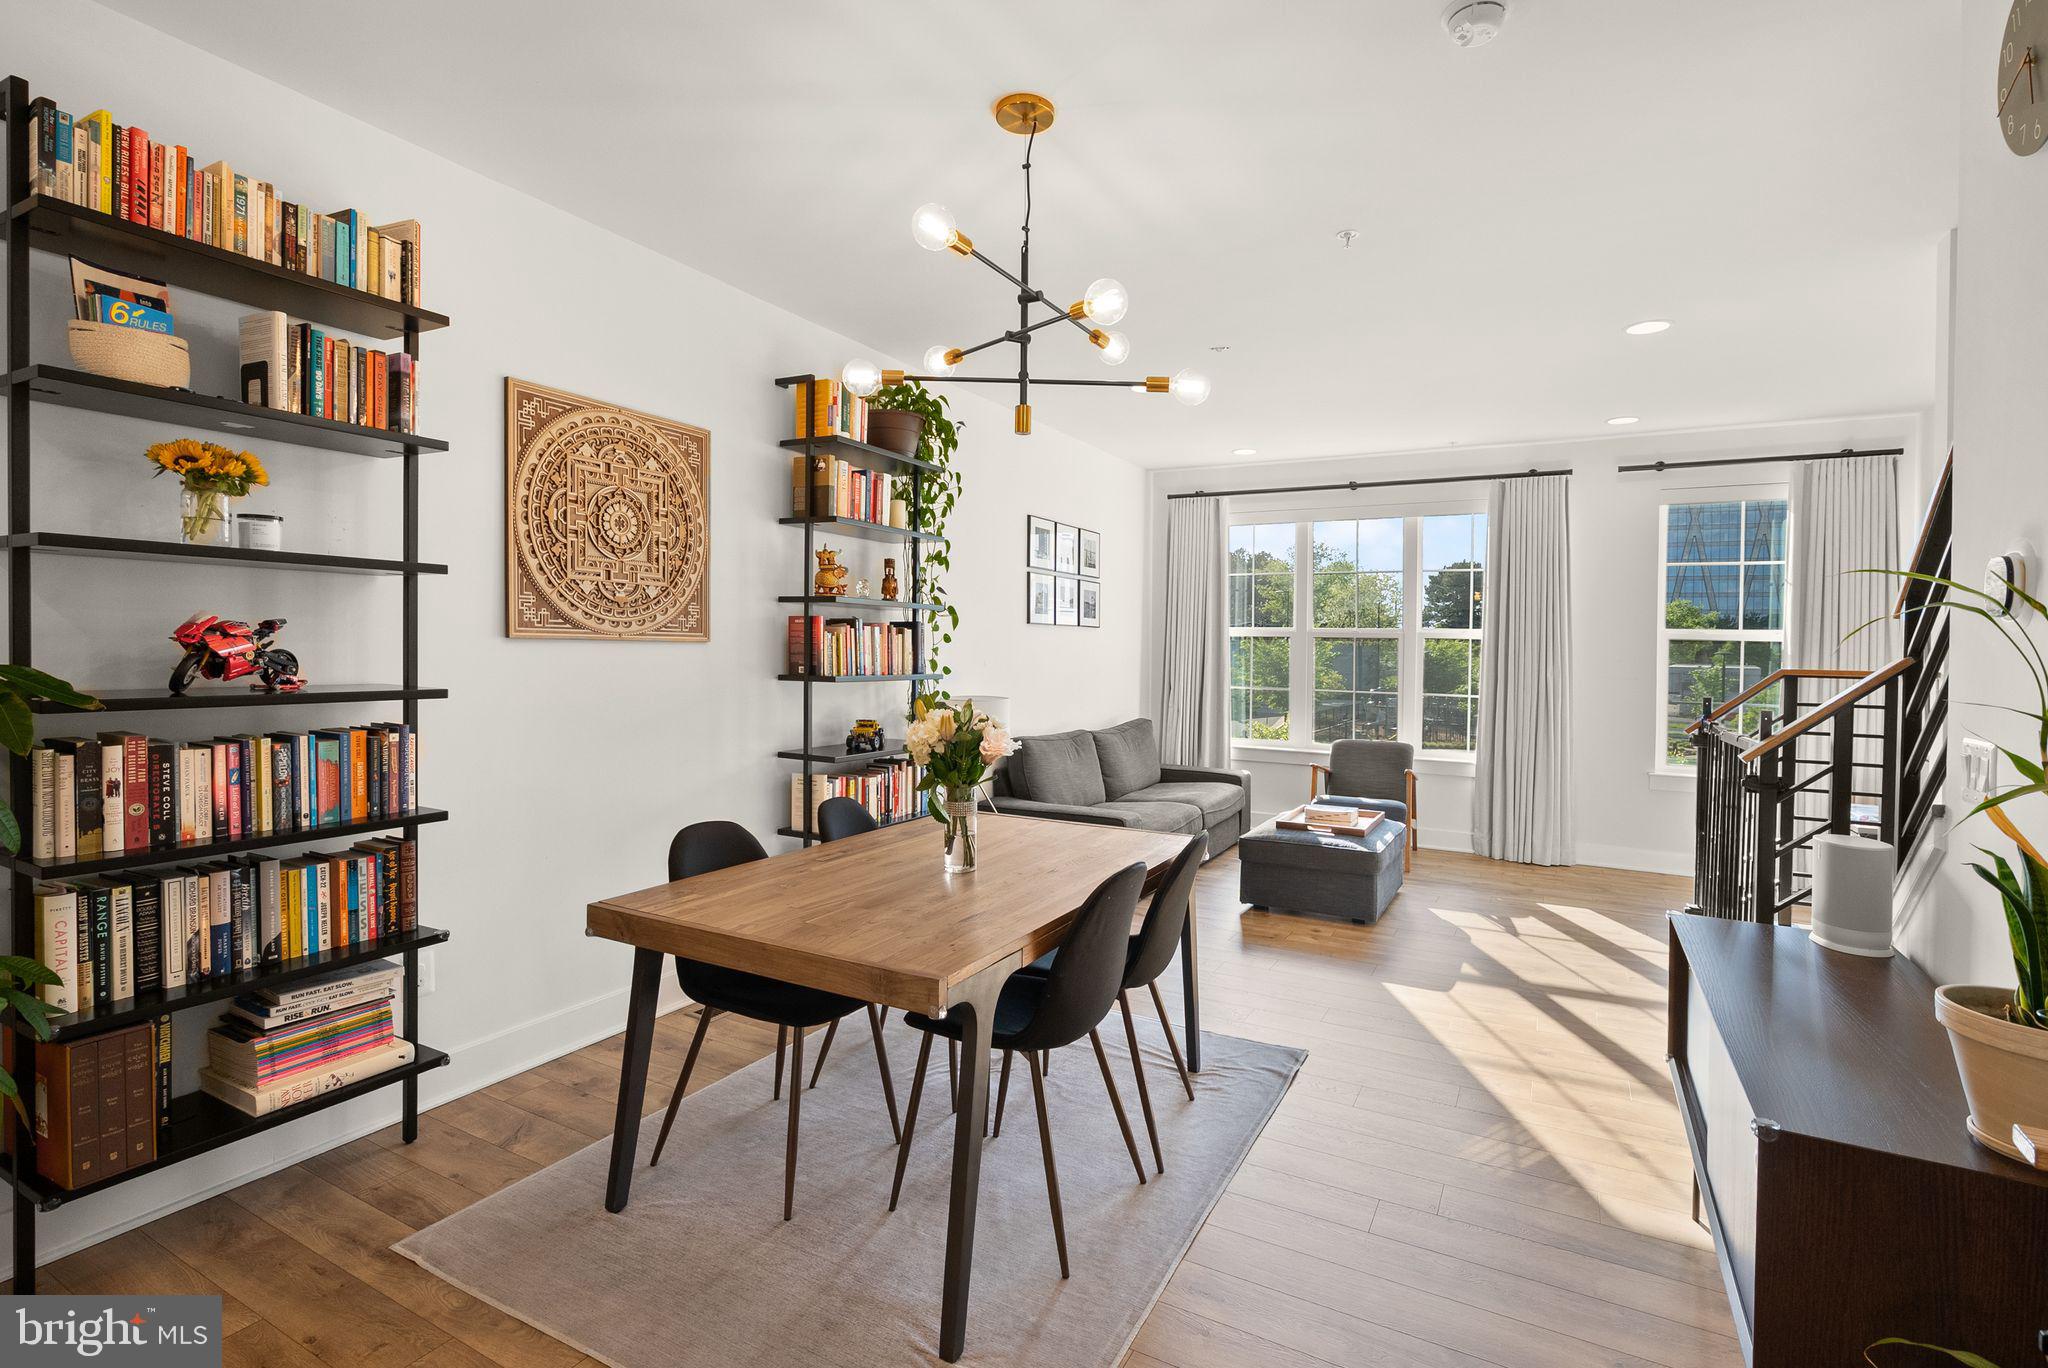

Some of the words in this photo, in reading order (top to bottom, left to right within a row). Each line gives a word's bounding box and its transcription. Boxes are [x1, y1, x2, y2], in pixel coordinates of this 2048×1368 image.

[2011, 8, 2021, 33] 11
[2002, 42, 2014, 67] 10
[2008, 114, 2014, 135] 8
[2020, 124, 2026, 145] 7
[2034, 120, 2041, 140] 6
[121, 130, 130, 148] NEW
[121, 150, 129, 176] RULES
[236, 194, 245, 216] 1971
[110, 302, 130, 324] 6
[130, 317, 168, 332] RULES
[316, 370, 322, 381] 90
[152, 754, 160, 819] DIRECTORATE
[233, 810, 239, 819] Pi
[189, 881, 197, 907] RICHARD
[241, 884, 250, 911] Breath
[78, 896, 89, 921] LESSONS
[96, 896, 108, 938] RANGE
[115, 897, 130, 932] LINCOLN
[189, 908, 197, 934] BRANSON
[79, 923, 89, 932] IN
[54, 921, 68, 973] CAPITAL
[79, 934, 89, 961] DISASTER
[335, 981, 354, 989] SLOW.
[284, 1011, 304, 1022] RISE
[311, 1005, 331, 1014] RUN.
[160, 1022, 170, 1064] WATCHMEN
